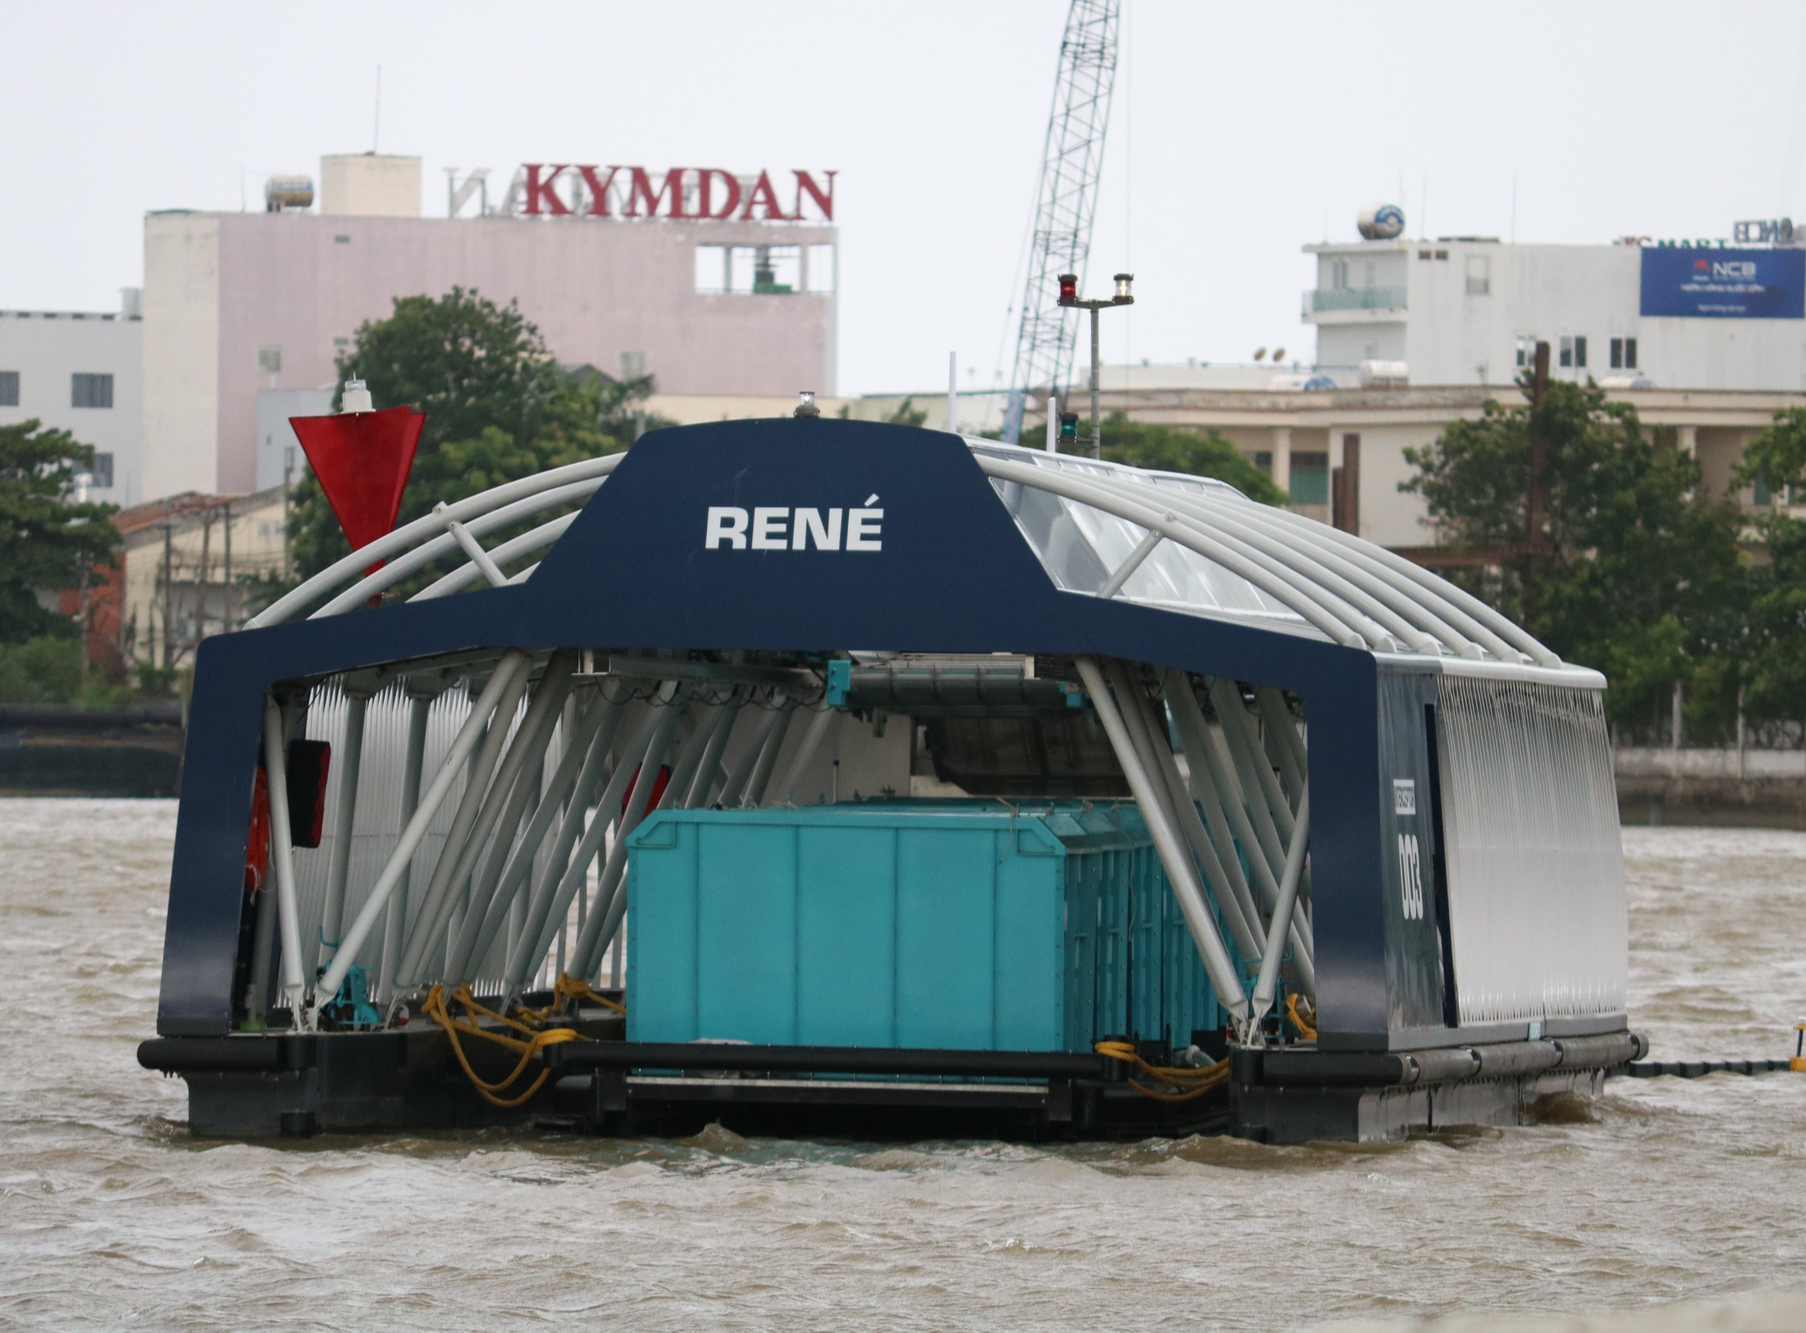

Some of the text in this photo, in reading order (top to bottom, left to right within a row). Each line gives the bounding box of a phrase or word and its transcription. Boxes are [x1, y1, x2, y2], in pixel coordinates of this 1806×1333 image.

[522, 163, 838, 222] KYMDAN
[1713, 262, 1756, 276] NCB
[705, 493, 884, 551] RENÉ
[1398, 833, 1424, 920] 003
